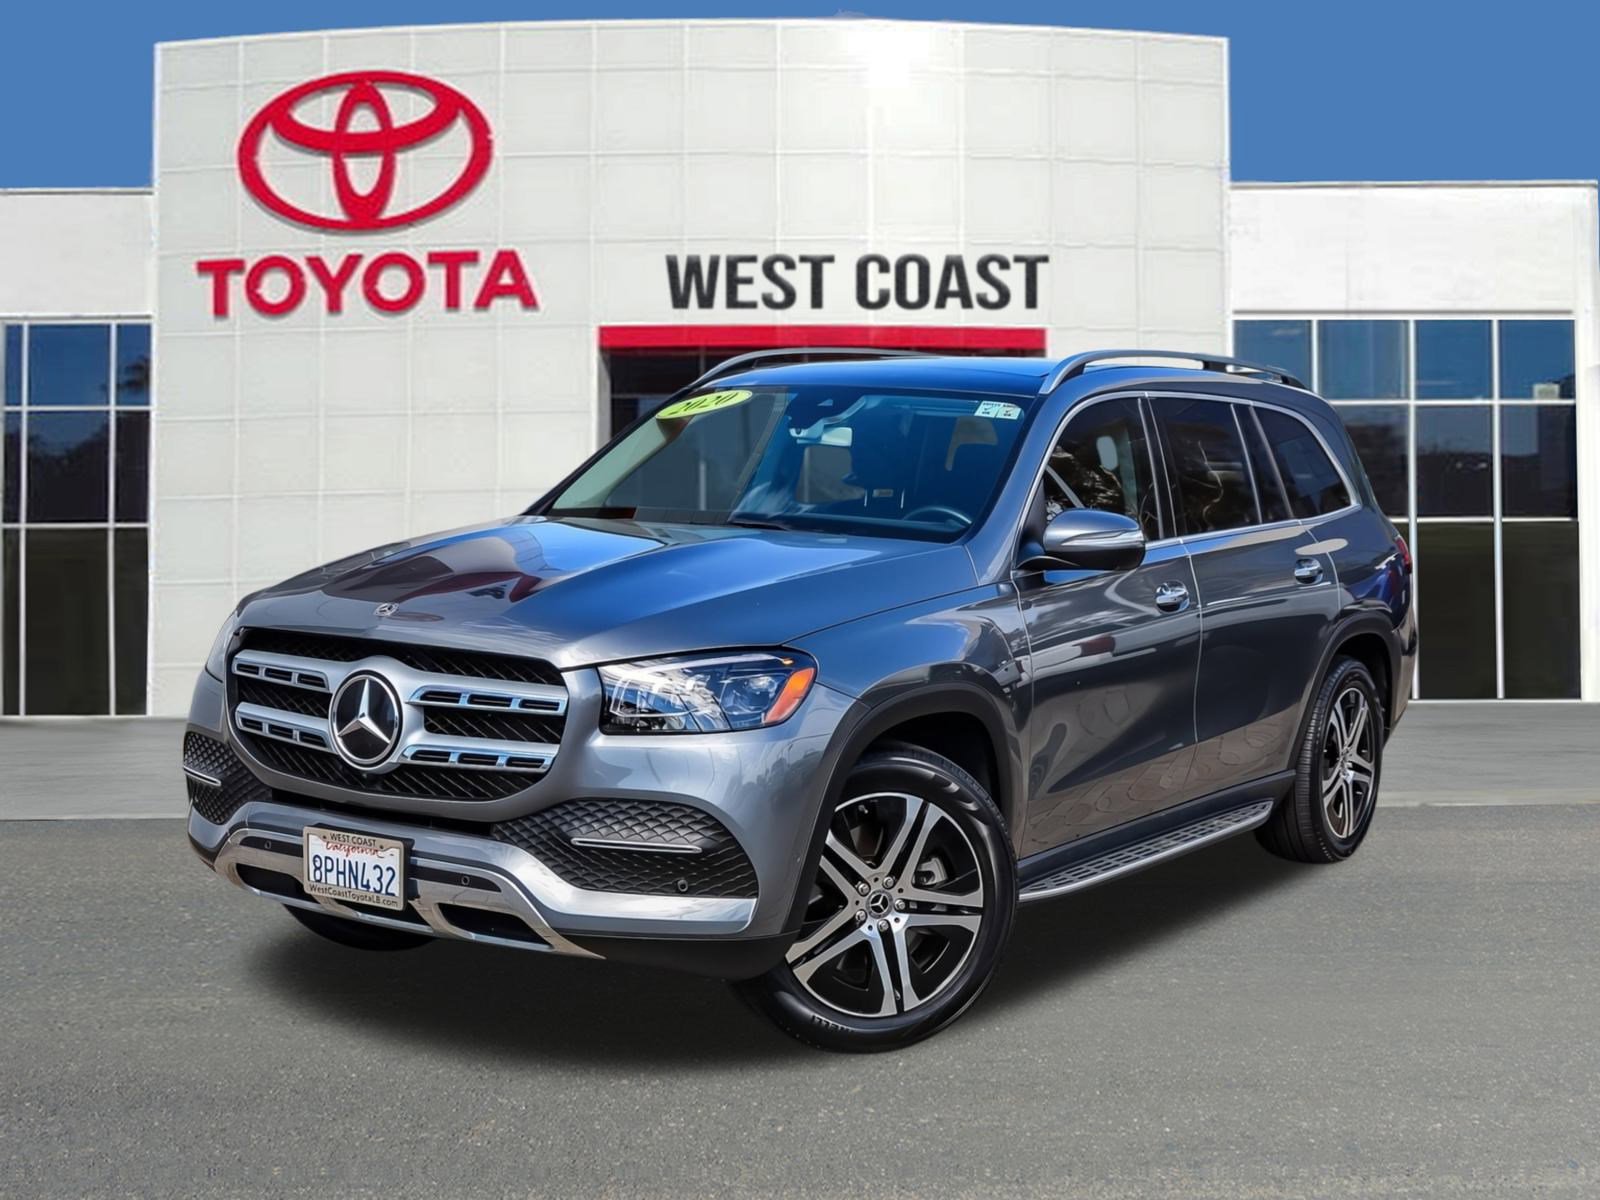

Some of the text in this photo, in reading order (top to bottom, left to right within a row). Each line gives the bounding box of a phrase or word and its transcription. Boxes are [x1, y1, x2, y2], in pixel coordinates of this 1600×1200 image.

[196, 250, 540, 318] TOYOTA
[666, 253, 1050, 310] WEST COAST
[667, 391, 740, 416] 2020
[330, 833, 377, 847] WEST COAST
[312, 854, 396, 897] 8PHN432
[309, 884, 398, 907] WestCoastToyotaLB.com
